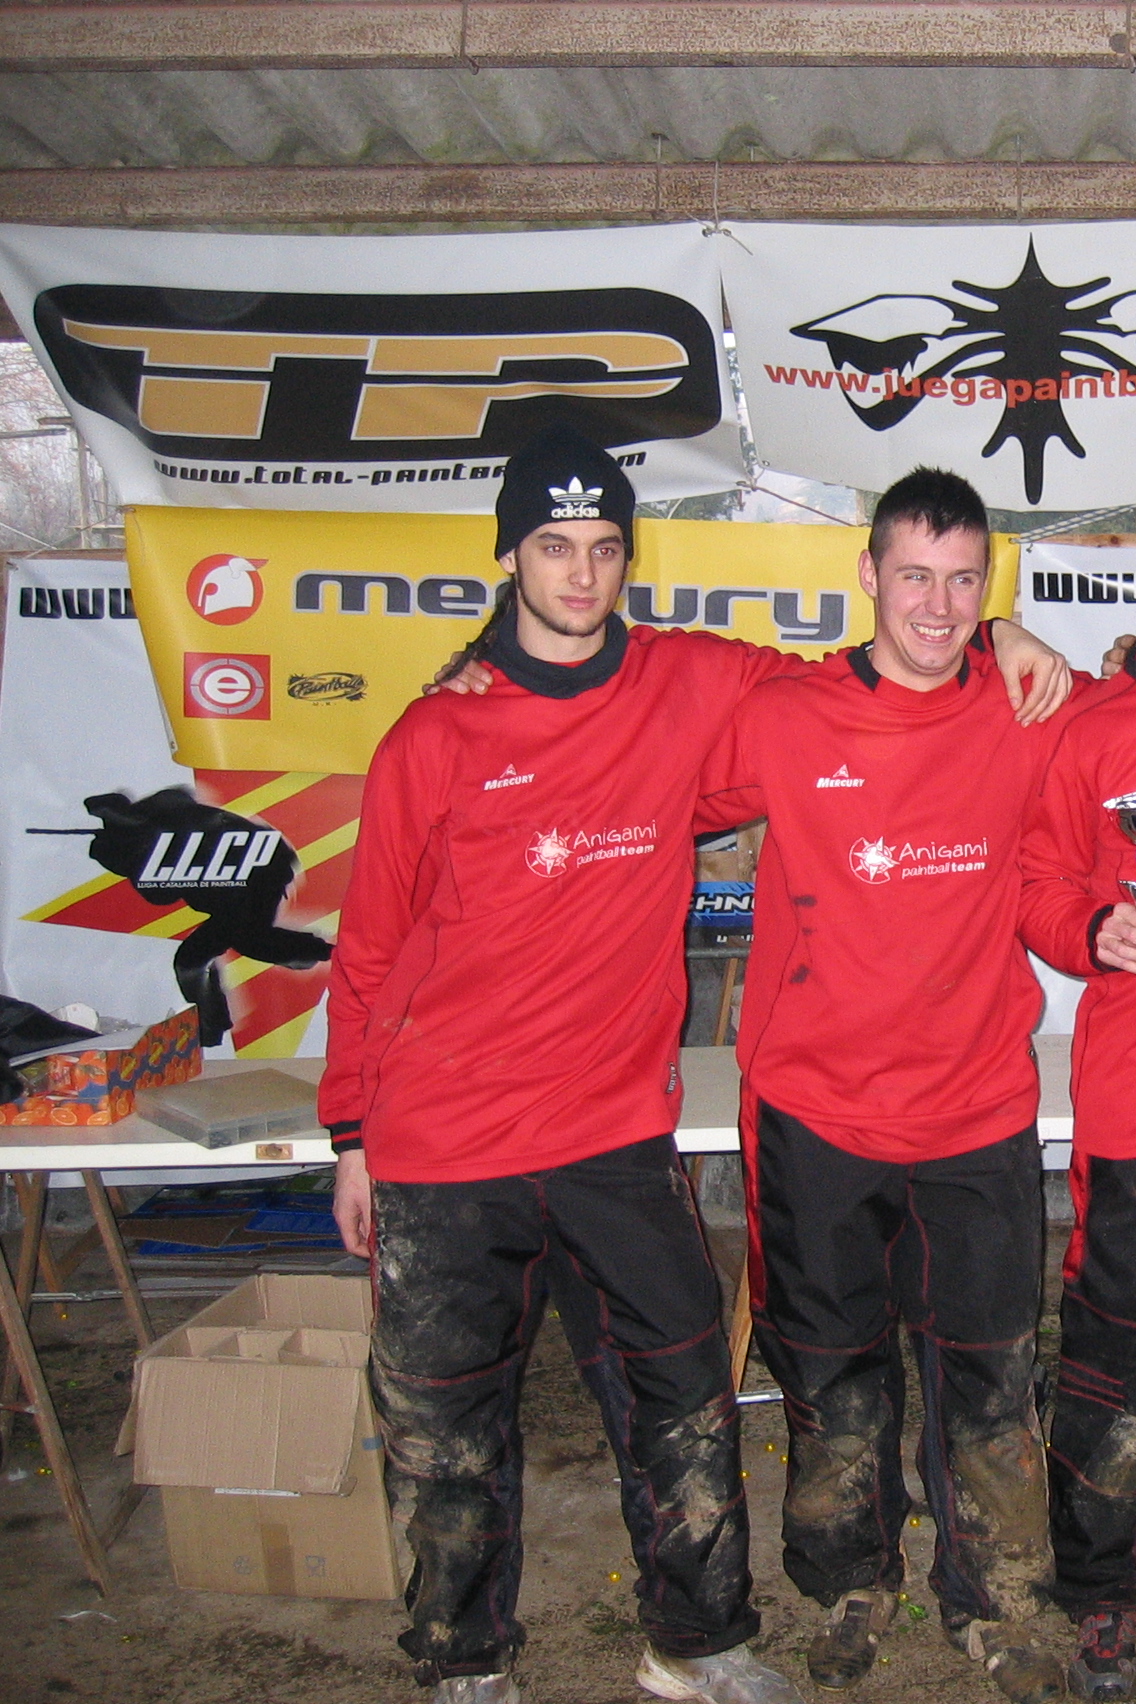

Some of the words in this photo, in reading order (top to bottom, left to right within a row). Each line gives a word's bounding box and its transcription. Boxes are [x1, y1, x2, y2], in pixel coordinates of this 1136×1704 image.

[550, 506, 601, 519] adidas
[291, 569, 847, 643] meury
[483, 773, 536, 791] MERCURY
[816, 777, 866, 788] MERCURY
[137, 830, 283, 882] LLCP
[160, 881, 199, 889] CATALANA
[210, 880, 248, 888] PAINTBALL
